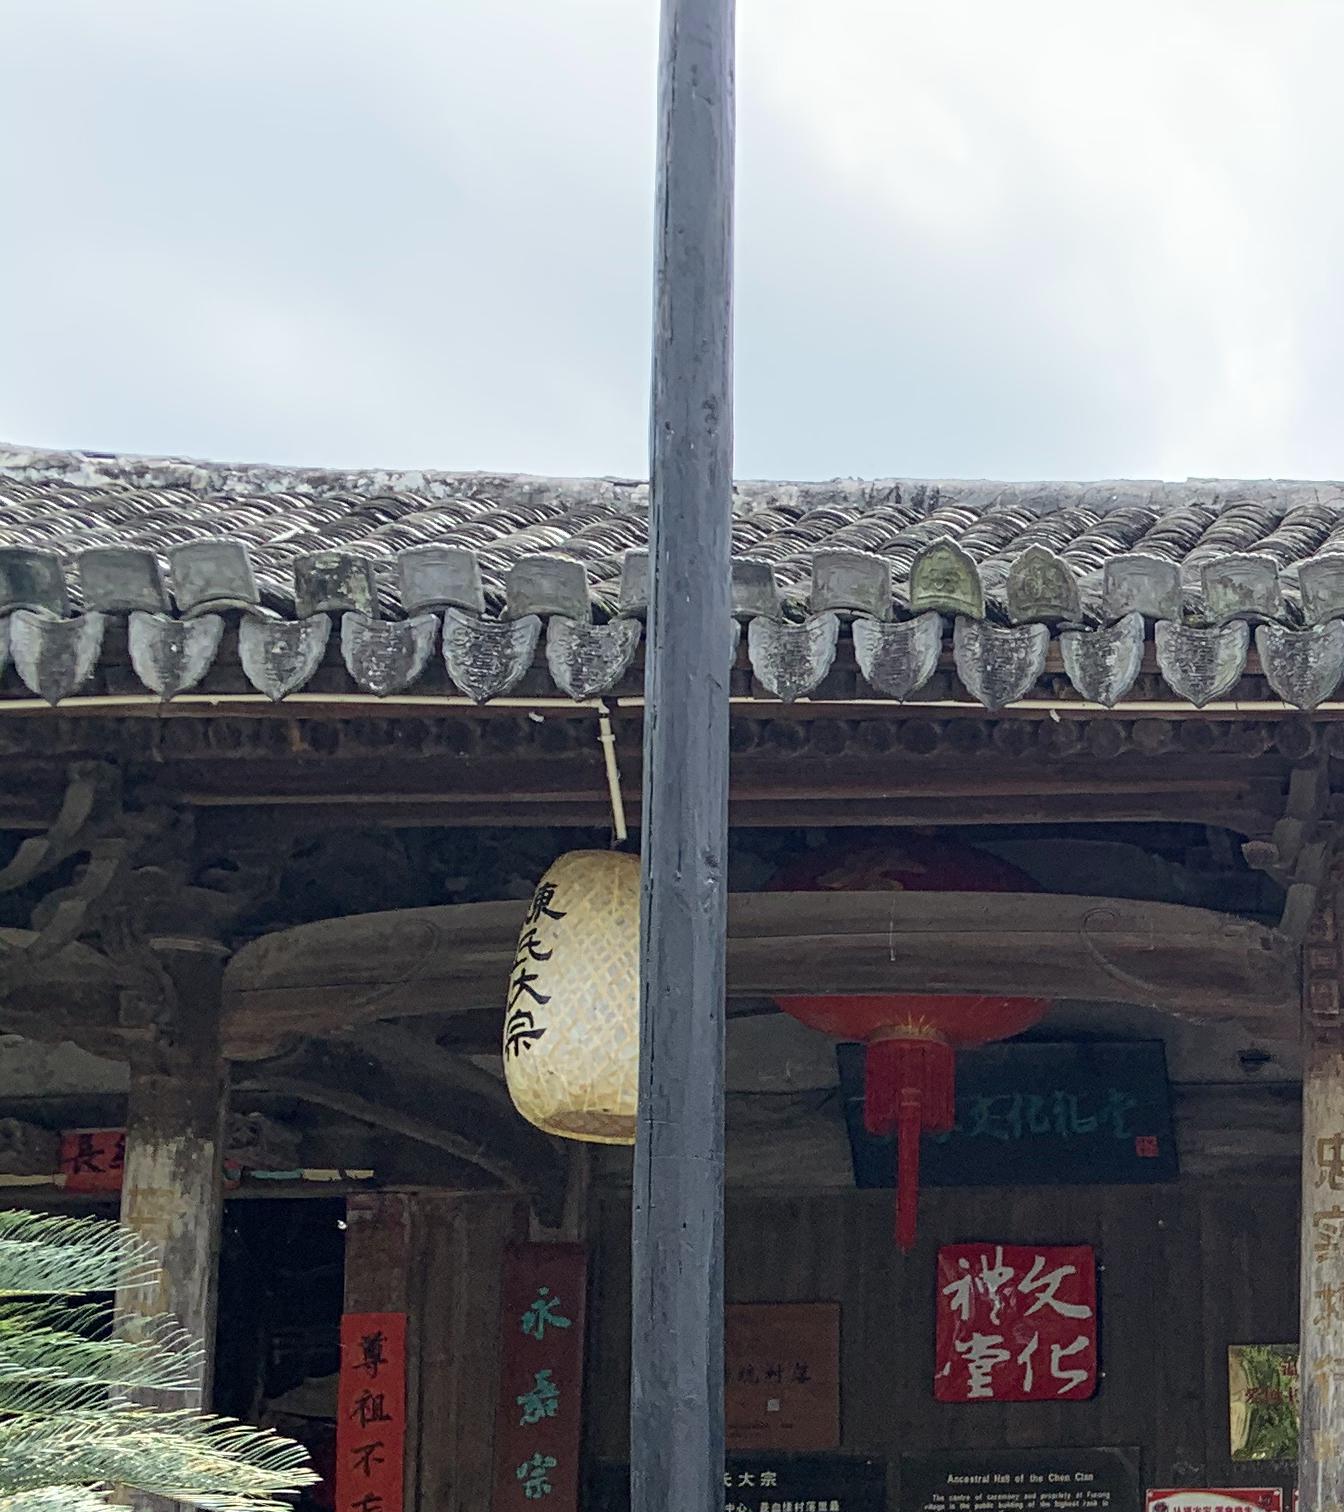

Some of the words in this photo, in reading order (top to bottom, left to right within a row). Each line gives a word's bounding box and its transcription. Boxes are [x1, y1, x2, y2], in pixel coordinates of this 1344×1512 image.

[947, 1475, 990, 1484] Ancestral
[1049, 1473, 1070, 1482] Chen
[1075, 1473, 1093, 1481] Clan
